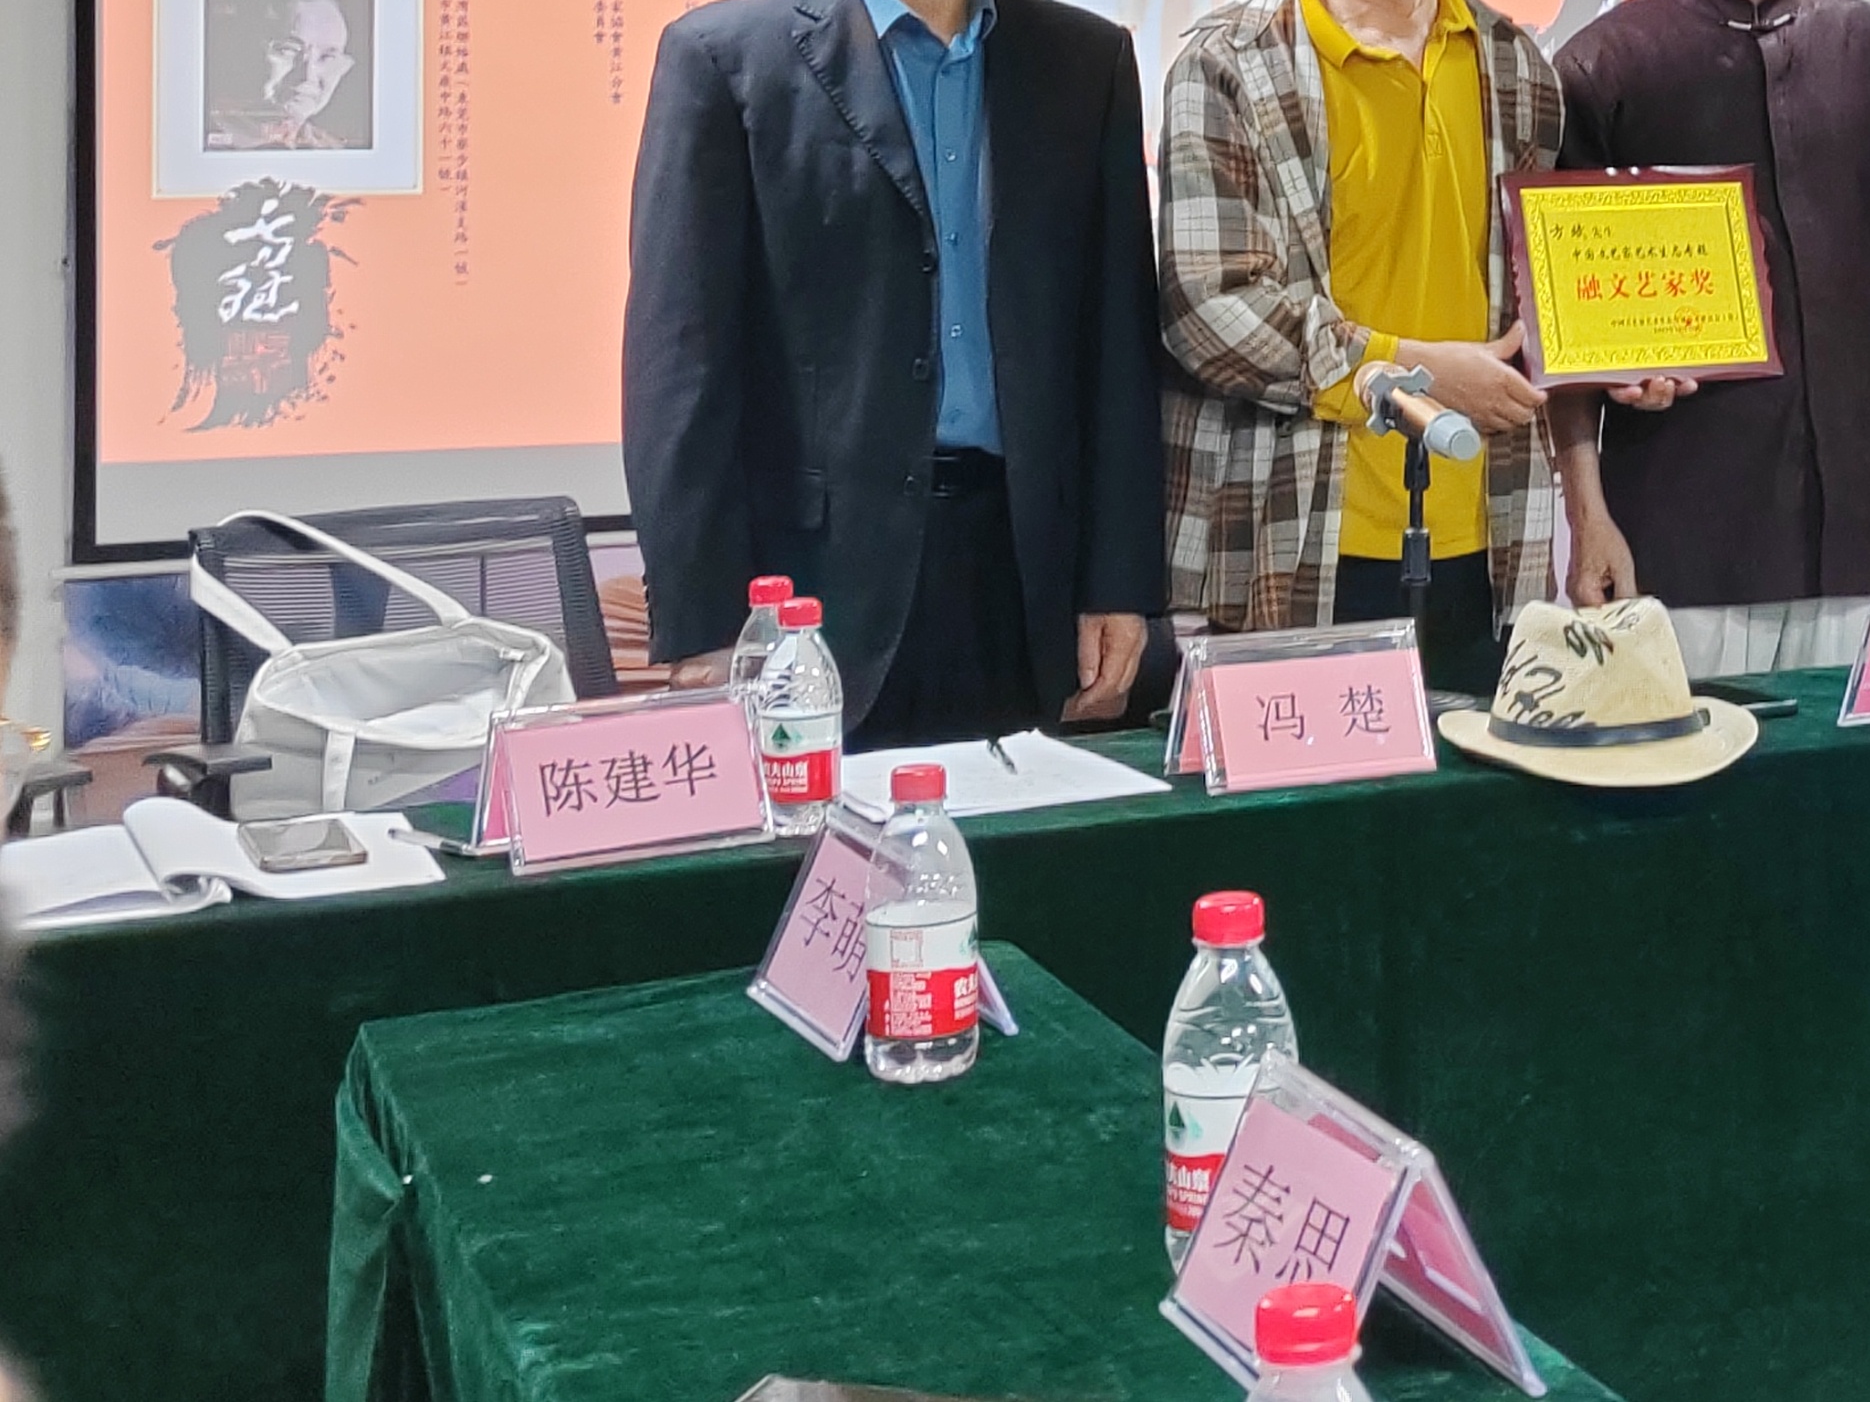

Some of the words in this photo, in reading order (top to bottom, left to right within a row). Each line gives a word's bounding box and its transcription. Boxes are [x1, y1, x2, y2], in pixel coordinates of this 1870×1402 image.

[1577, 269, 1715, 301] 融文艺家奖
[1254, 684, 1393, 744] 冯楚
[538, 742, 719, 818] 陈建华
